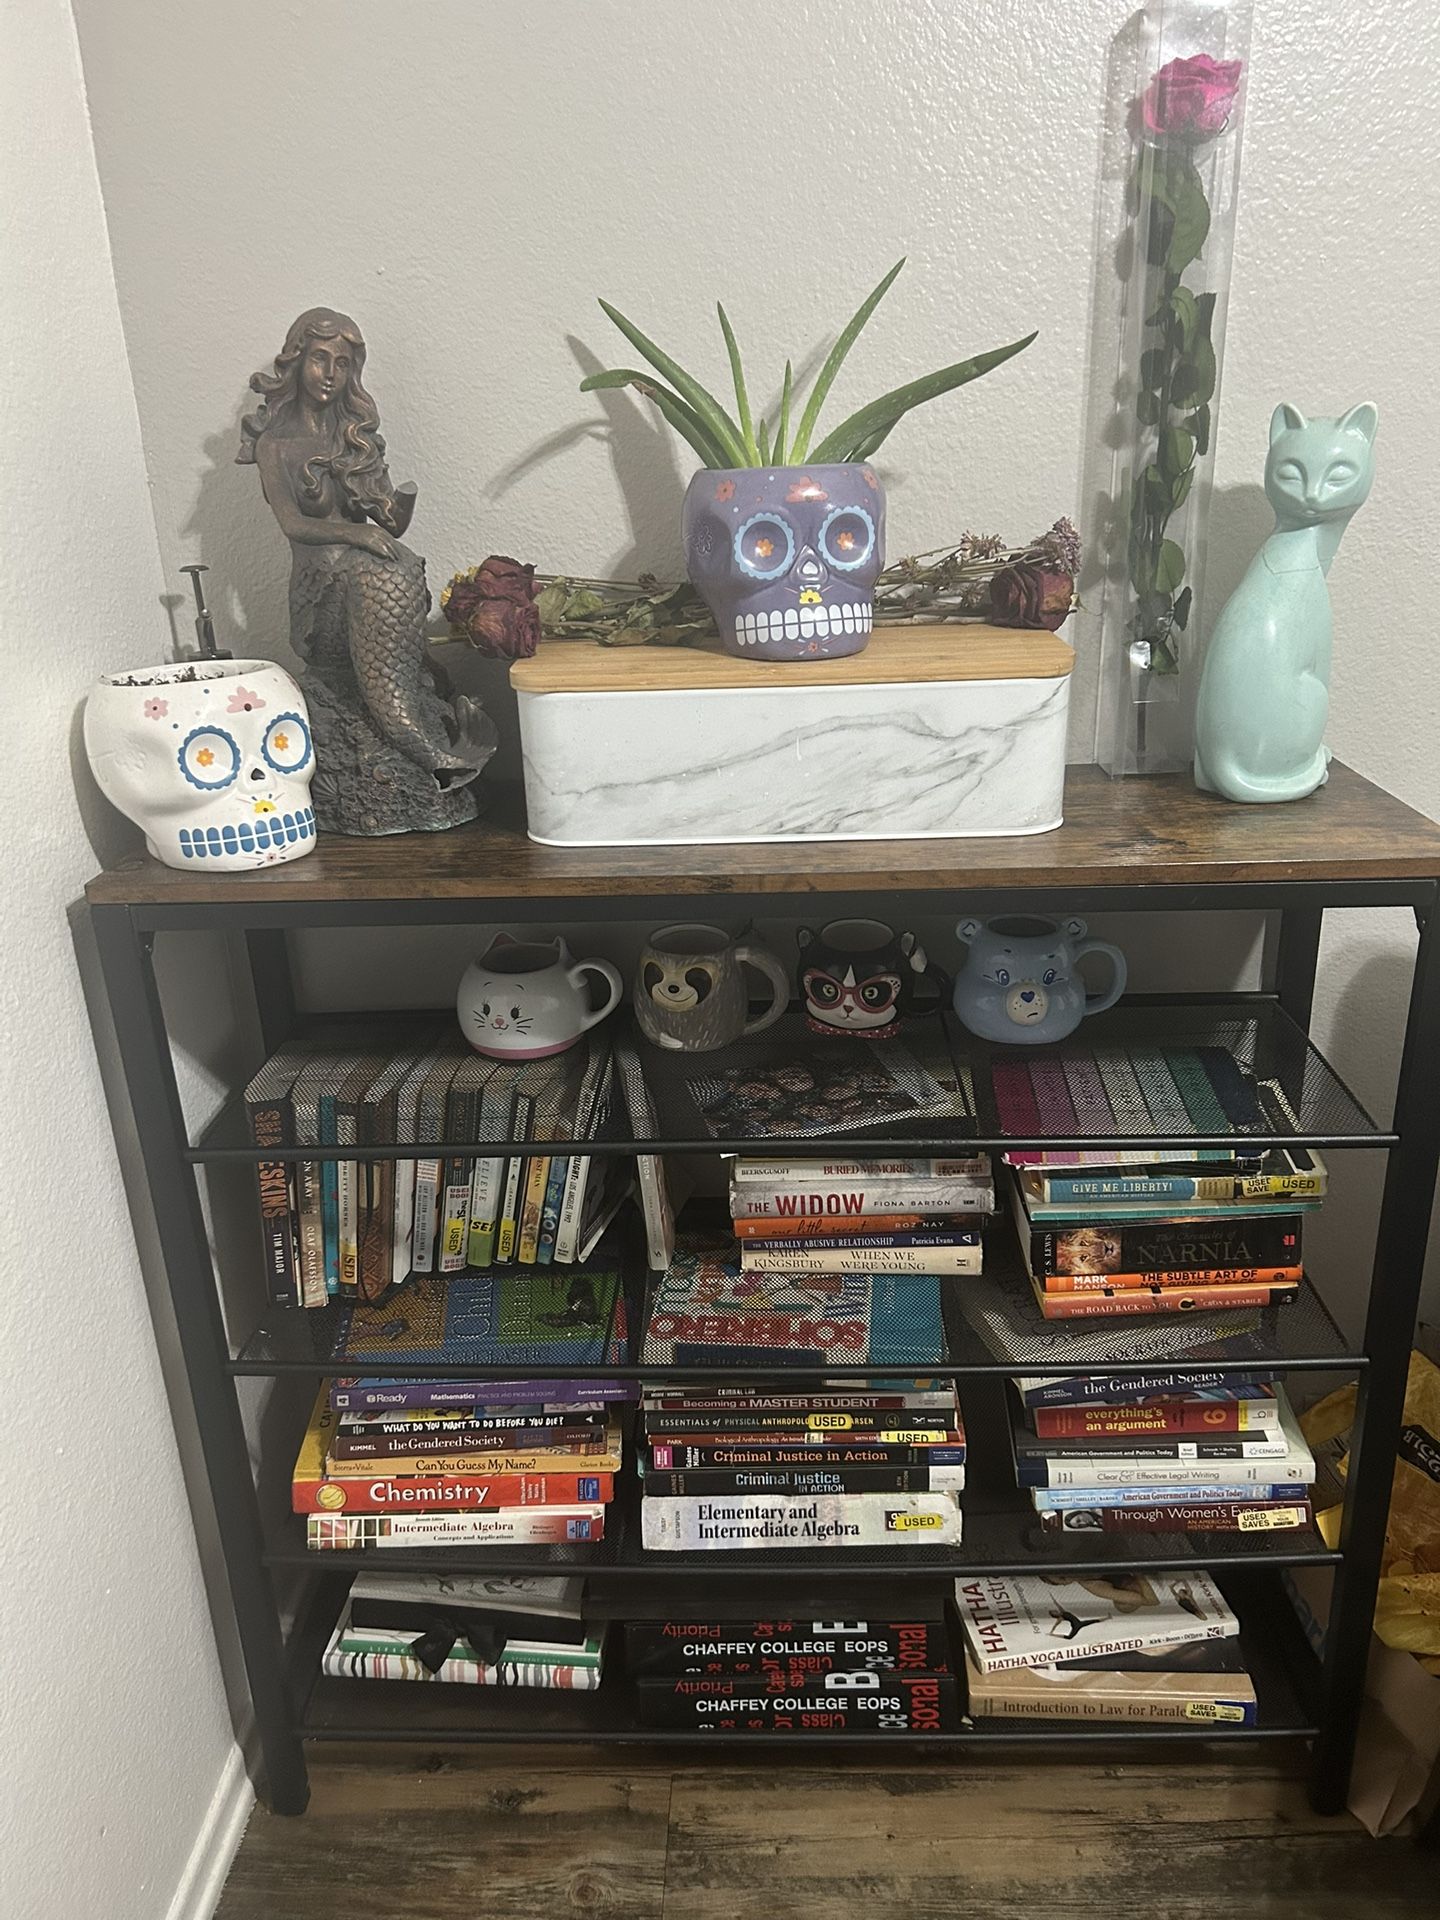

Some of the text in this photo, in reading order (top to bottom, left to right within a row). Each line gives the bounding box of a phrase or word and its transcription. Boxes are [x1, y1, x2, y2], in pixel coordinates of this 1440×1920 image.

[823, 1161, 915, 1175] BURIED MEMORIES
[304, 1175, 313, 1198] AWAY
[479, 1160, 489, 1202] ELIEVE
[1072, 1182, 1173, 1193] GIVE ME LIBERTY!
[1281, 1179, 1315, 1189] USED
[1246, 1184, 1270, 1194] SAVE
[747, 1193, 865, 1216] THE WIDOW
[910, 1199, 951, 1207] BARTON
[564, 1211, 572, 1223] 1992
[797, 1220, 822, 1235] little
[895, 1221, 919, 1229] ROZ
[307, 1226, 315, 1246] OLAF
[449, 1227, 459, 1251] USED
[502, 1230, 511, 1252] USED
[911, 1236, 954, 1245] Patricia Evans
[764, 1237, 895, 1249] VERBALLY ABUSIVE RELATIONSHIP
[273, 1232, 285, 1274] TIM MAJOR
[851, 1250, 916, 1260] WHEN WE
[1137, 1241, 1255, 1265] NARNIA
[344, 1255, 355, 1278] SED
[753, 1259, 825, 1269] KINGSBURY
[840, 1261, 926, 1271] WERE YOUNG
[1073, 1275, 1108, 1284] MARK
[1140, 1269, 1258, 1282] THE SUBTLE ART OF
[1086, 1305, 1113, 1314] ROAD
[1115, 1304, 1140, 1312] BACK
[1152, 1302, 1173, 1311] YOU
[1084, 1373, 1226, 1395] the Gendered Society
[376, 1394, 408, 1404] Ready
[430, 1392, 475, 1400] Mathematics
[683, 1400, 737, 1408] Becoming
[749, 1398, 810, 1408] MASTER
[812, 1397, 879, 1408] STUDENT
[1085, 1407, 1163, 1420] everything's
[1203, 1408, 1227, 1424] 6
[383, 1416, 564, 1433] WHAT DO YOU WANT TO DO BEFORE YOU DIE?
[660, 1417, 809, 1427] ESSENTIALS of PHYSICAL ANTHROPOLO
[813, 1416, 846, 1427] USED
[851, 1417, 874, 1425] ARSEN
[1086, 1422, 1101, 1431] an
[1105, 1419, 1167, 1432] argument
[350, 1434, 506, 1451] KIMMEL the Gendered Society
[896, 1433, 929, 1443] USED
[713, 1449, 889, 1462] Criminal Justice in Action
[456, 1459, 486, 1470] Guess
[487, 1458, 504, 1473] My
[504, 1458, 537, 1470] Name?
[736, 1471, 841, 1485] Criminal Justice
[1097, 1473, 1118, 1481] Clear
[1136, 1472, 1167, 1480] Effective
[1169, 1471, 1189, 1480] Legal
[1191, 1471, 1220, 1480] Writing
[369, 1481, 489, 1504] Chemistry
[800, 1484, 845, 1493] IN ACTION
[1122, 1490, 1243, 1501] American Government and Politics Today
[698, 1503, 817, 1521] Elementary and
[1112, 1508, 1163, 1523] Through
[1167, 1507, 1227, 1518] Women's
[1243, 1513, 1267, 1521] USED
[394, 1521, 514, 1534] Intermediate Algebra
[903, 1517, 935, 1527] USED
[1241, 1520, 1270, 1528] SAVES
[699, 1521, 860, 1541] Intermediate Algebra
[988, 1577, 1020, 1626] Illustr
[962, 1582, 1007, 1653] HATHA
[662, 1622, 720, 1637] Priority
[1149, 1637, 1161, 1645] Kirk
[683, 1640, 888, 1656] CHAFFEY COLLEGE EOPS
[987, 1638, 1143, 1671] HATHA YOGA ILLUSTRATED
[674, 1680, 734, 1694] Priority
[696, 1697, 901, 1712] CHAFFEY COLLEGE EOPS
[1003, 1701, 1187, 1717] Introduction to Law for Parale
[1192, 1703, 1216, 1711] USED
[1190, 1709, 1217, 1718] SAVES
